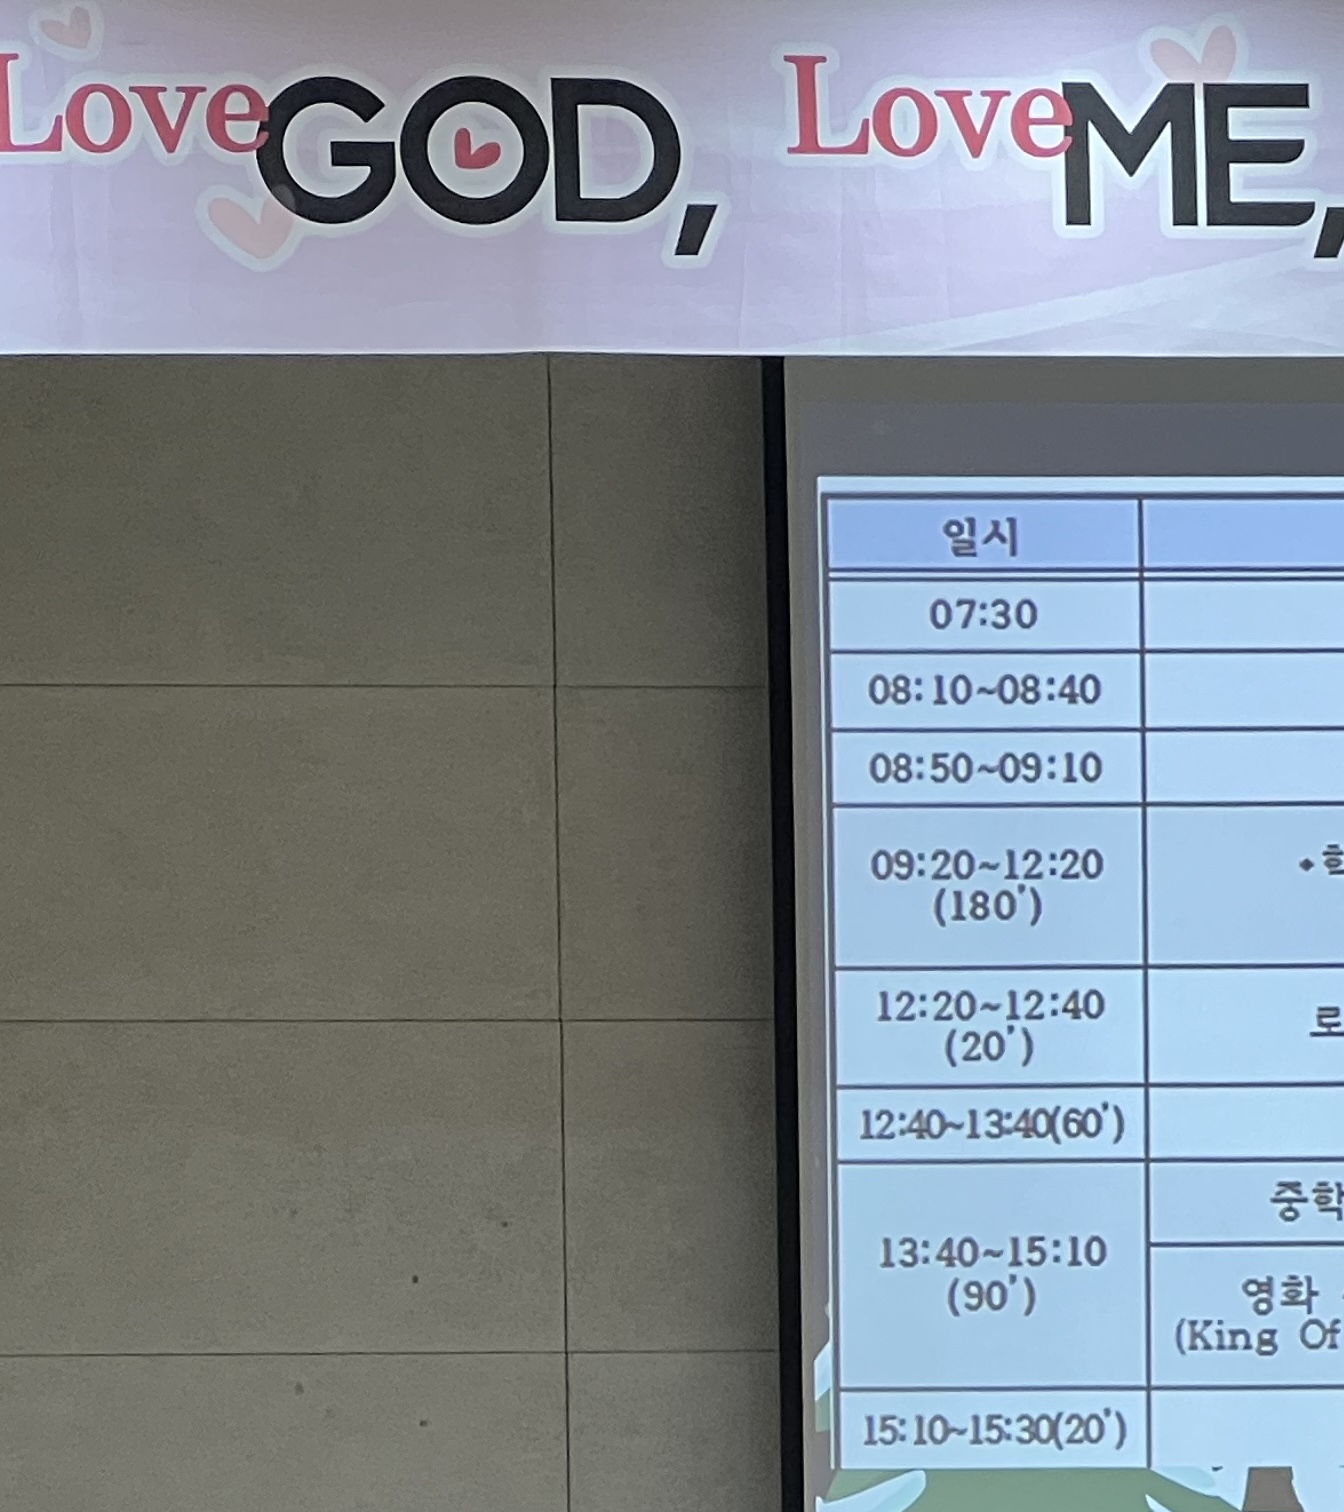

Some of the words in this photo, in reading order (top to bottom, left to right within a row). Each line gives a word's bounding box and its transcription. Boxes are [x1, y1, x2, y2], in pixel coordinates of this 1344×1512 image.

[0, 53, 271, 153] Love
[256, 76, 718, 256] GOD,
[785, 55, 1073, 156] Love
[942, 516, 1018, 558] 일시
[929, 598, 1038, 630] 07:30
[868, 673, 1102, 706] 08:10~08:40
[869, 751, 1103, 784] 08:50~09:10
[870, 848, 1104, 881] 09:20~12:20
[877, 988, 1106, 1022] 12:20~12:40
[879, 1235, 1108, 1269] 13:40~15:10
[1241, 1274, 1320, 1316] 영화
[1175, 1318, 1279, 1357] (King
[1299, 1318, 1342, 1350] Of
